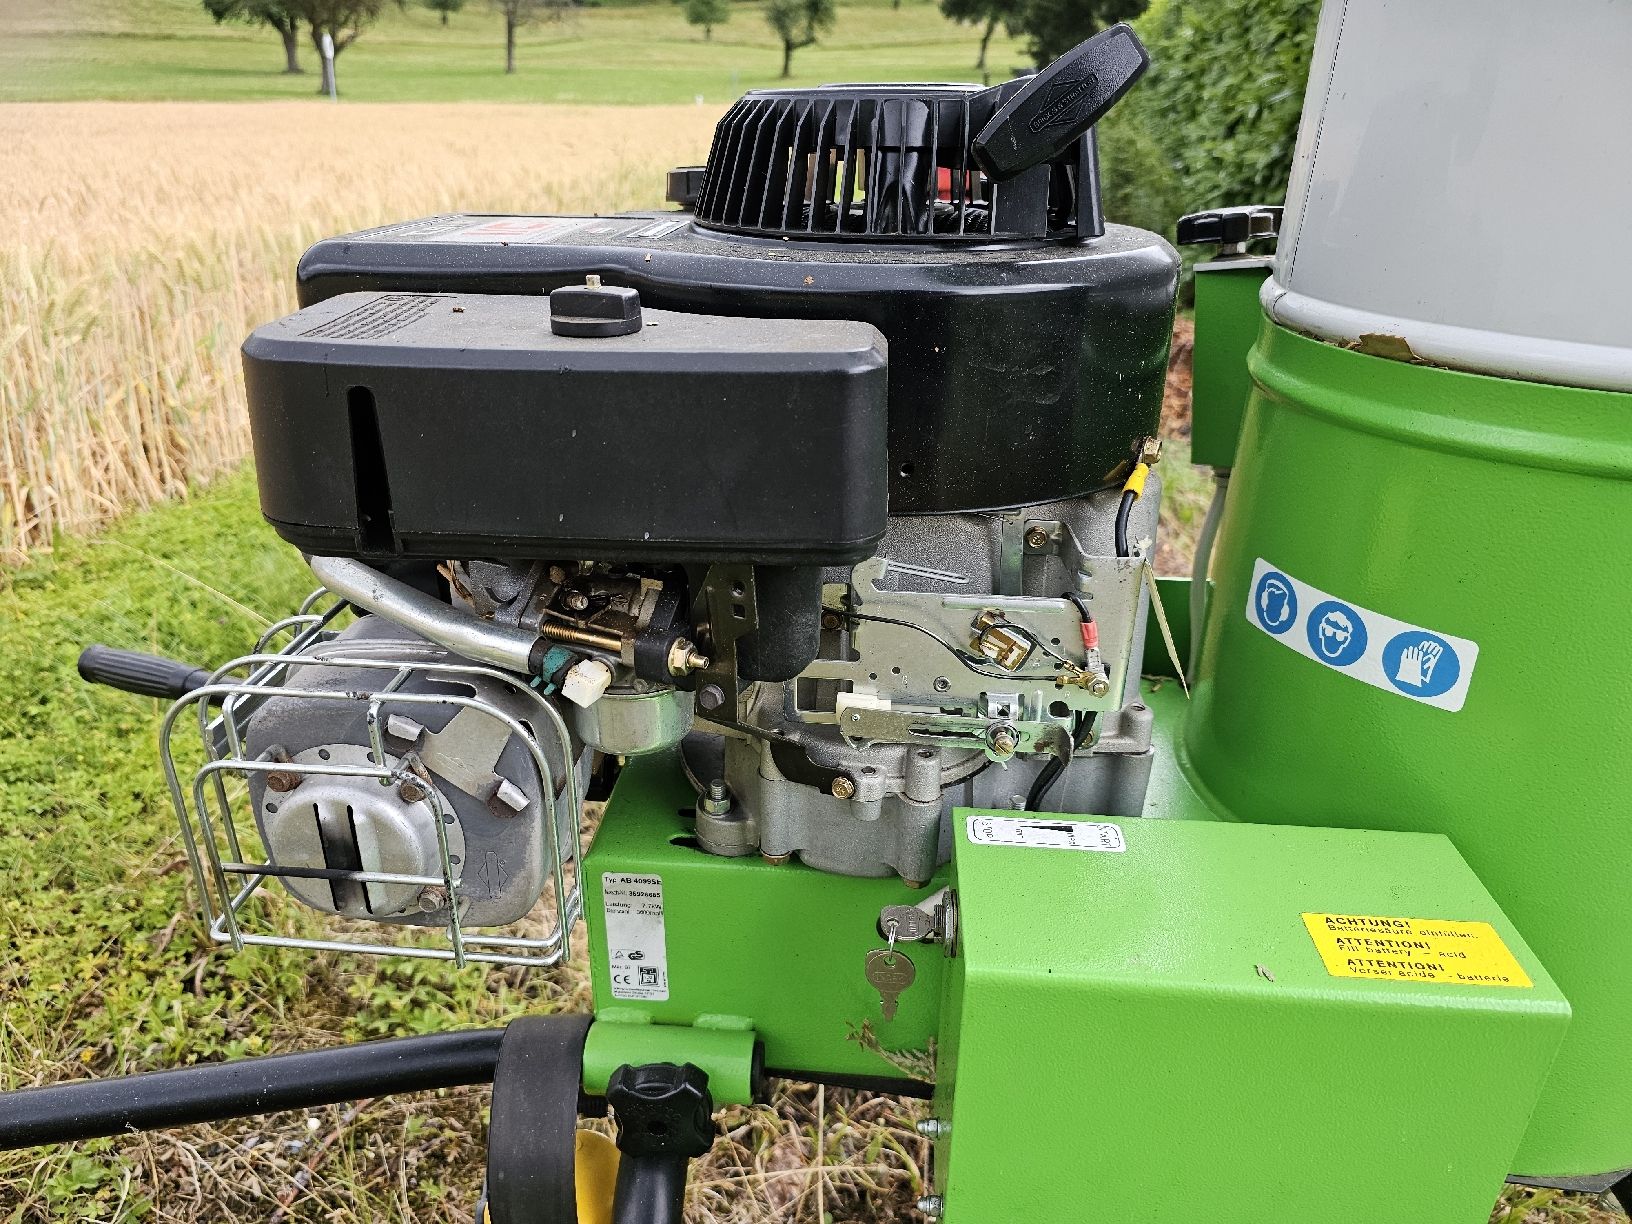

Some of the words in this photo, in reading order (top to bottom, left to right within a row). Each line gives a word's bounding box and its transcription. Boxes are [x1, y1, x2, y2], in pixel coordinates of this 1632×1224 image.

[1325, 916, 1411, 928] ACHTUNG!
[1336, 937, 1431, 950] ATTENTION!
[1365, 946, 1411, 956] battery
[1438, 951, 1467, 959] acid
[1347, 958, 1445, 972] ATTENTION!
[1456, 972, 1511, 983] batterie
